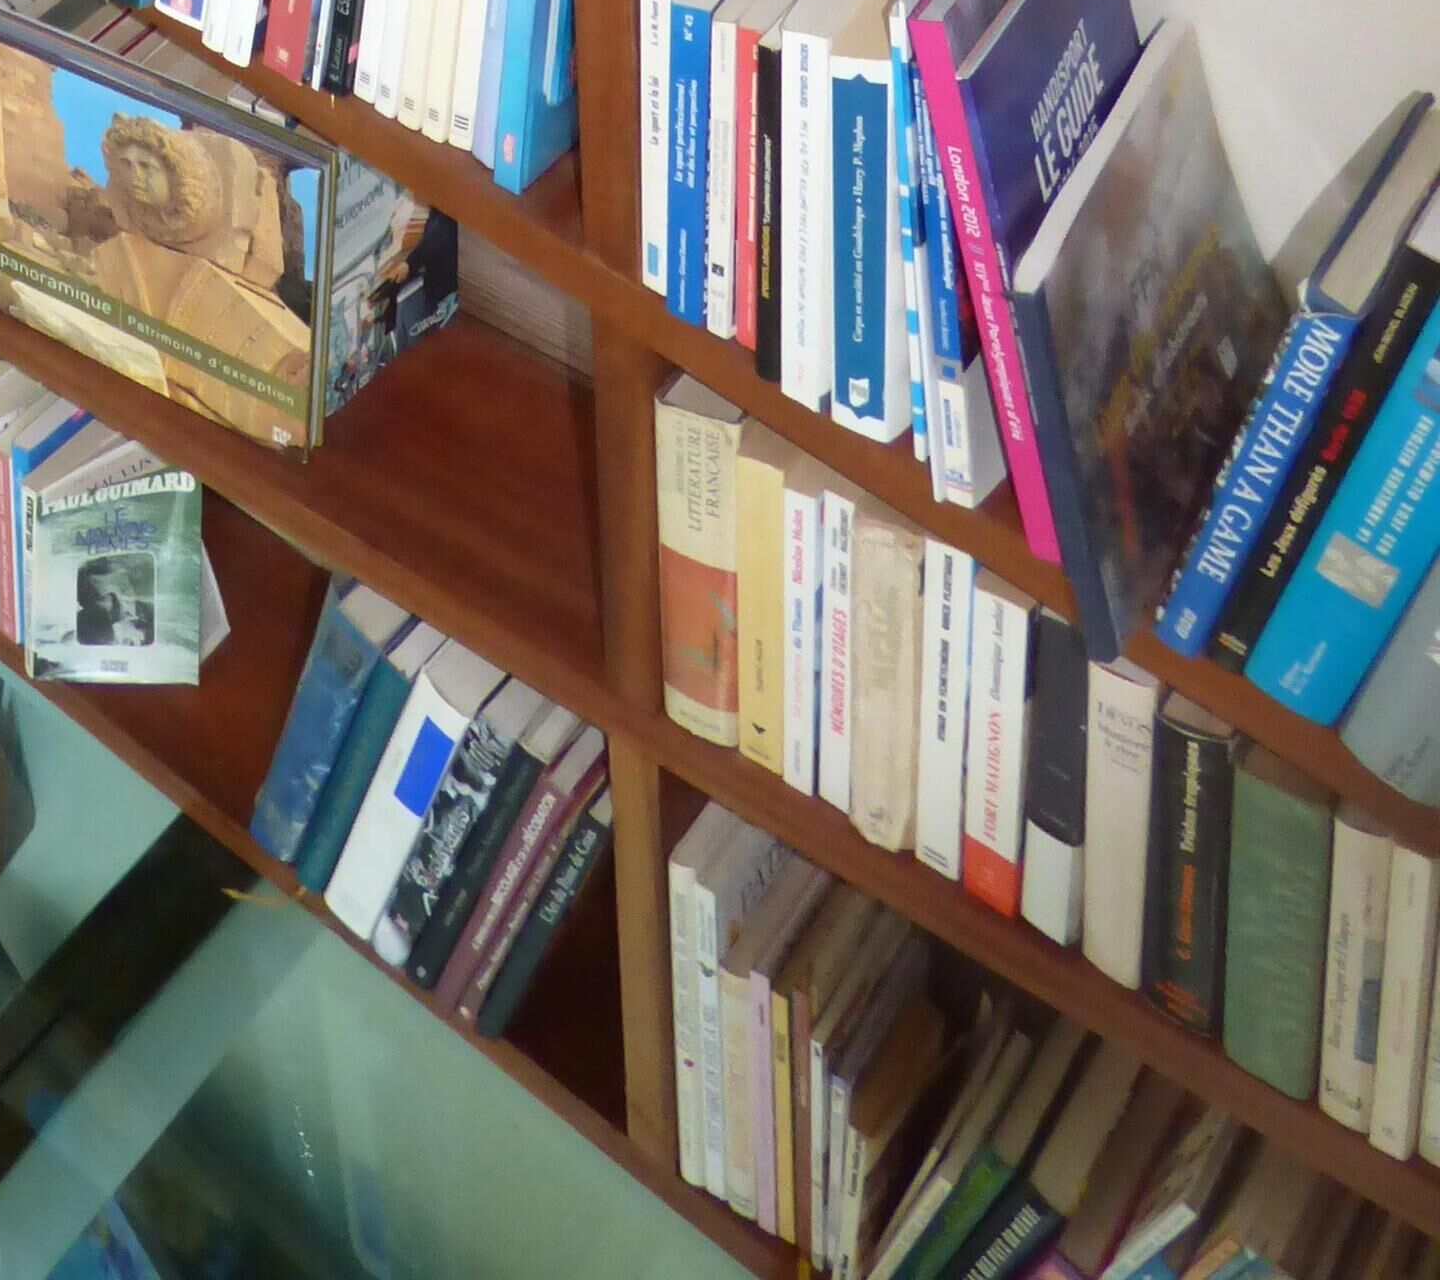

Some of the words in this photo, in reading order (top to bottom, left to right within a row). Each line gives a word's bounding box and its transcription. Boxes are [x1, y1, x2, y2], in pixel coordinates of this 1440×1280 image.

[1030, 17, 1088, 143] HANDISPORT
[651, 111, 661, 134] sport
[675, 83, 686, 148] professionnel
[1034, 131, 1060, 204] LE
[1056, 42, 1105, 158] GUIDE
[674, 149, 686, 168] sport
[852, 168, 866, 197] Harry
[948, 145, 976, 204] London
[852, 206, 866, 259] Guadeloupe
[961, 206, 980, 238] 2012
[852, 277, 864, 307] société
[980, 293, 999, 321] Jeux
[0, 251, 113, 316] panoramique
[208, 354, 296, 407] d'exception
[852, 316, 865, 342] Corps
[981, 321, 1014, 409] Paralympiques
[1282, 318, 1343, 404] MORE
[1245, 401, 1305, 485] THAN
[41, 493, 94, 516] PAUL
[95, 471, 196, 502] GUIMARD
[687, 425, 703, 533] LITTERATURE
[705, 429, 722, 519] FRANÇAISE
[1228, 483, 1262, 503] A
[1258, 551, 1283, 579] Les
[1289, 465, 1329, 531] défigurés
[1320, 422, 1350, 464] Berlin
[1356, 527, 1373, 543] LA
[1396, 414, 1435, 468] HISTOIRE
[103, 506, 129, 524] LE
[1197, 502, 1253, 585] GAME
[1388, 501, 1415, 533] JEUX
[86, 539, 150, 554] TEMPS
[791, 545, 803, 585] Nicolas
[832, 607, 848, 668] D'OTAGES
[988, 645, 1005, 702] Dominique
[830, 669, 846, 737] MÉMOIRES
[985, 710, 1003, 802] MATIGNON
[1182, 740, 1202, 807] tropiques
[982, 801, 998, 842] FORT
[1179, 807, 1200, 854] Tristes
